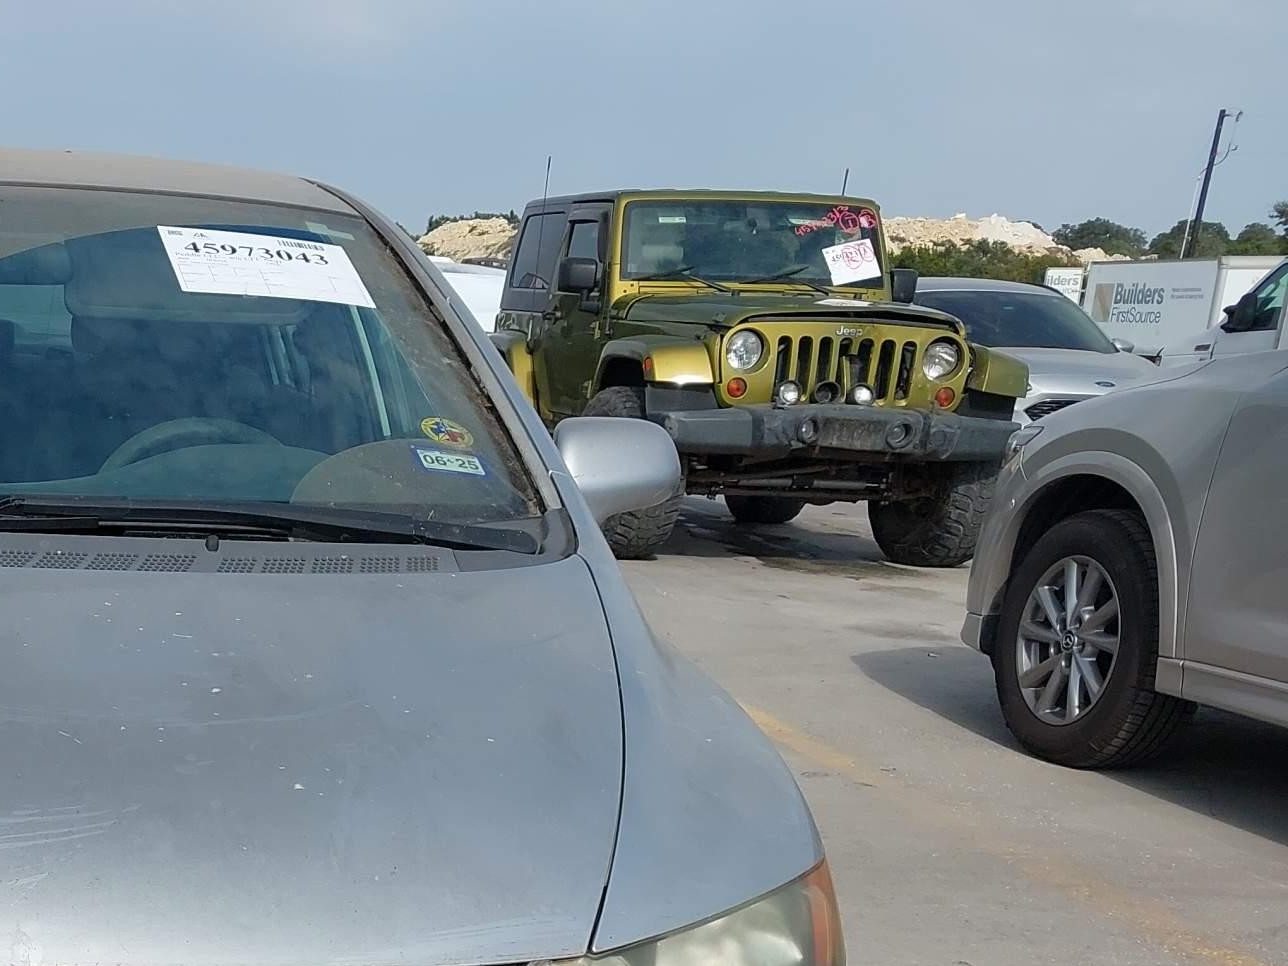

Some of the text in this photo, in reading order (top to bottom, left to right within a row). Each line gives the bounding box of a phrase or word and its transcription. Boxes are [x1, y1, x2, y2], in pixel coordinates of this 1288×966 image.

[184, 241, 329, 266] 45973043
[1114, 282, 1165, 305] Builders
[1111, 306, 1161, 324] FirstSource
[836, 326, 863, 337] Jeep
